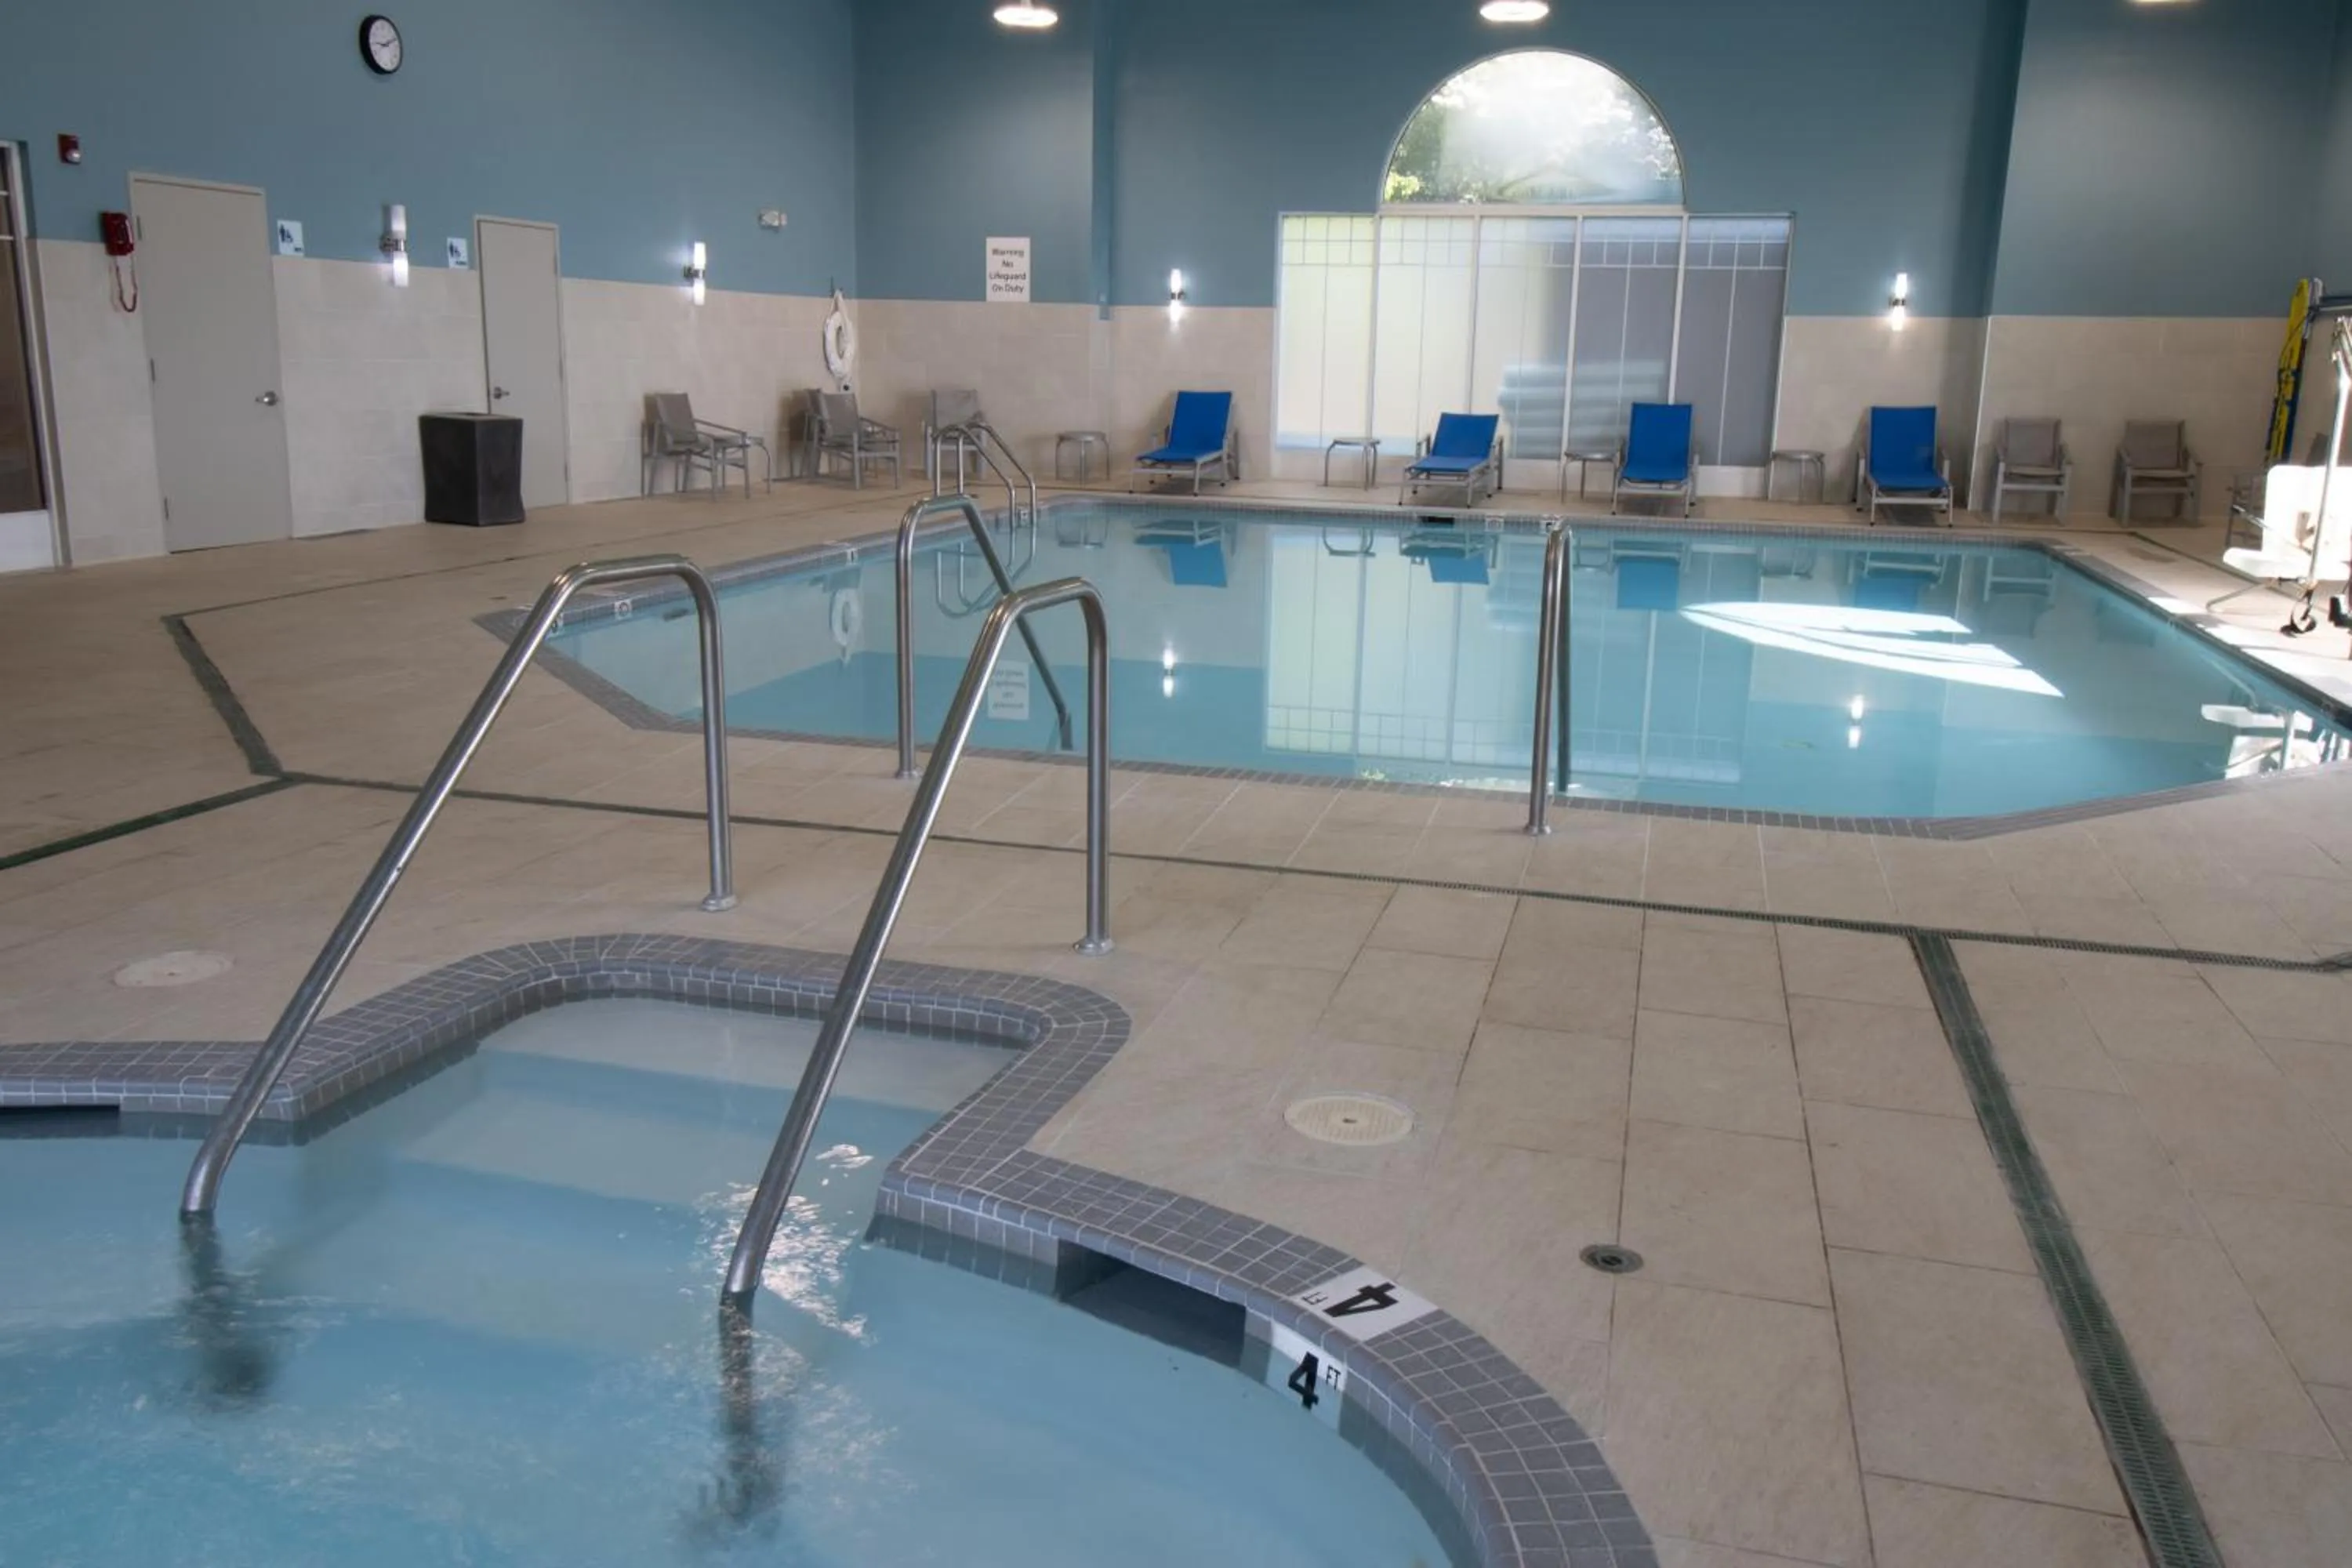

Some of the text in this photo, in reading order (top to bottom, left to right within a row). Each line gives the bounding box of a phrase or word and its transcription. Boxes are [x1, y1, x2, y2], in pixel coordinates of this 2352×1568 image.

[1002, 260, 1014, 268] No
[989, 271, 1026, 282] Lifeguard
[992, 283, 1024, 294] On Duty
[1301, 1281, 1399, 1318] 4 FT
[1288, 1352, 1341, 1410] 4 FT
